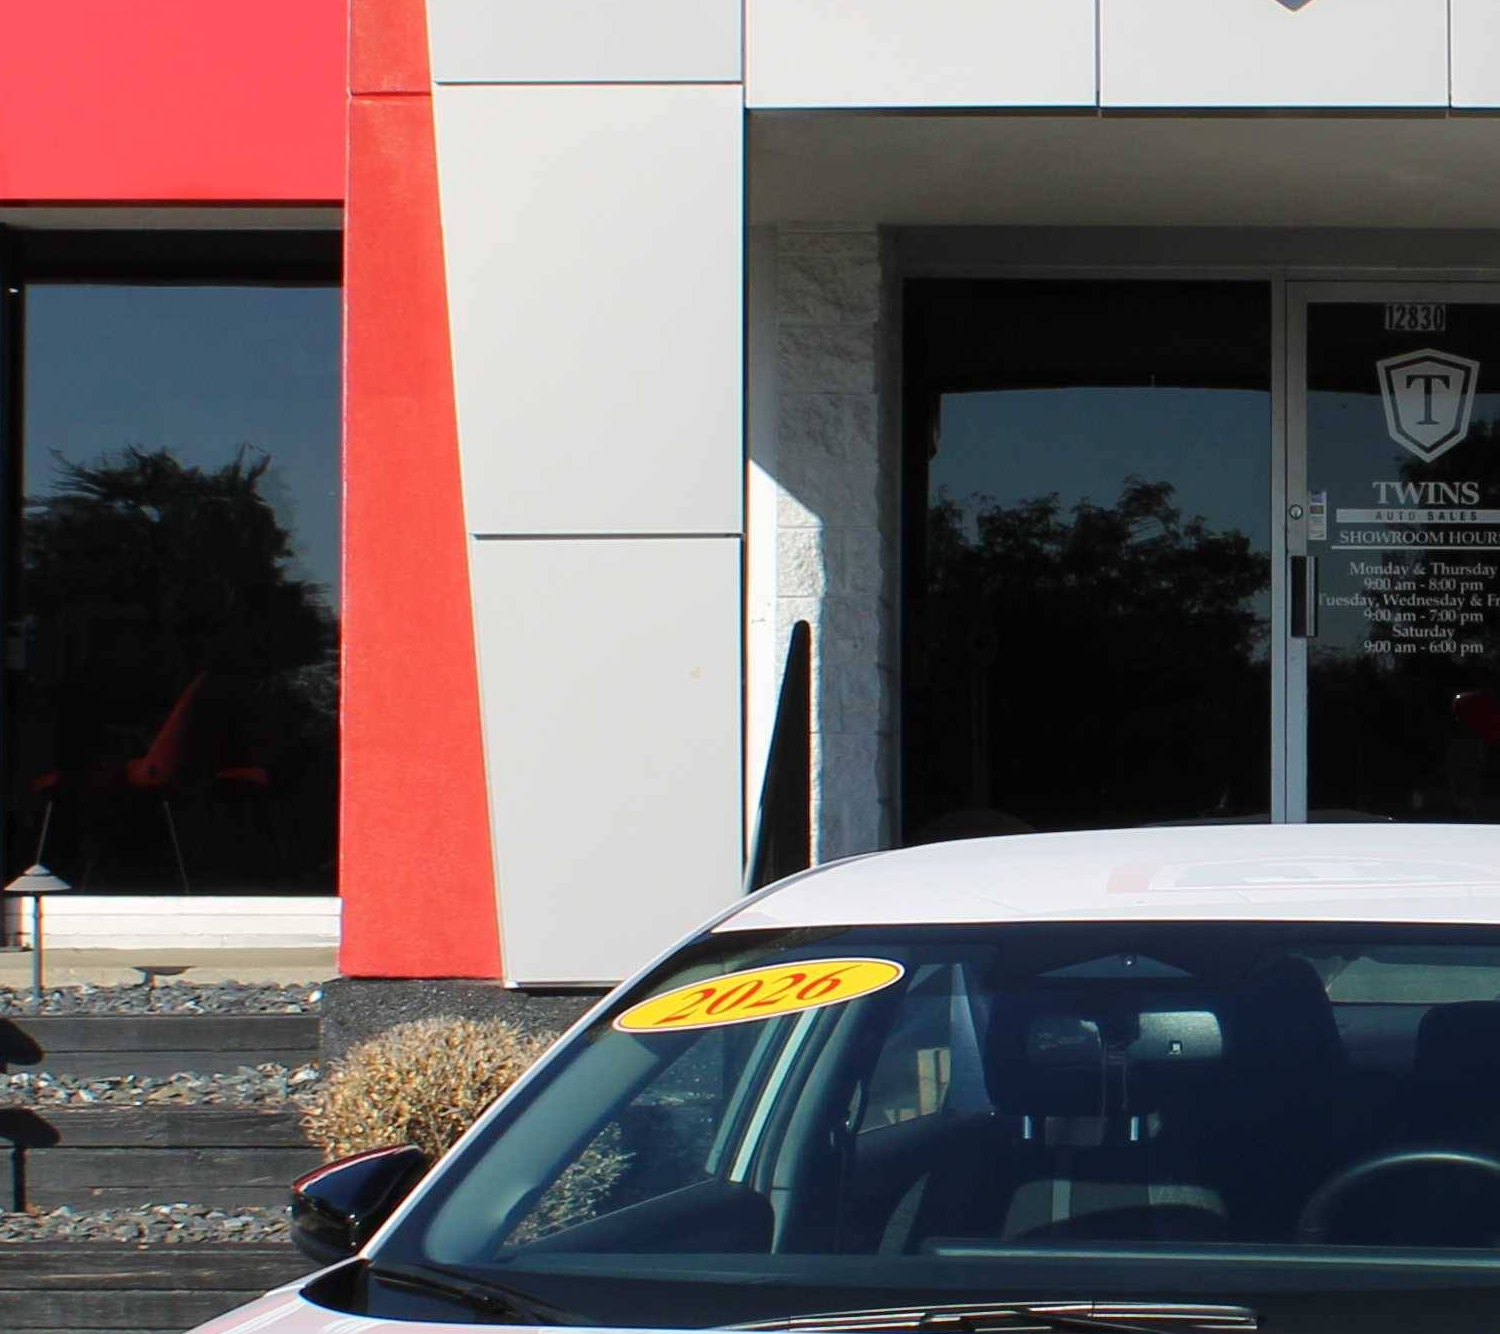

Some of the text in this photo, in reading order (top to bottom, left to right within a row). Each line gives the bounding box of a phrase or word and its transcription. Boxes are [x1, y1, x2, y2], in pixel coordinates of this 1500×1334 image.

[1387, 304, 1445, 330] 12830
[1405, 374, 1450, 425] T
[1372, 481, 1480, 505] TWINS
[1375, 510, 1478, 521] AUTO SALES
[1339, 530, 1444, 545] SHOWROOM
[1349, 562, 1498, 578] Monday & Thursday
[1363, 578, 1391, 591] 9:00
[1394, 580, 1417, 591] am
[1428, 578, 1457, 591] 8:00
[1460, 580, 1484, 594] pm
[1318, 593, 1380, 609] Tuesday,
[1383, 593, 1465, 609] Wednesday
[1470, 594, 1483, 607] &
[1363, 609, 1391, 622] 9:00
[1394, 611, 1417, 622] am
[1428, 609, 1457, 622] 7:00
[1460, 611, 1484, 625] pm
[1392, 624, 1456, 640] Saturday
[1363, 640, 1391, 653] 9:00
[1394, 642, 1417, 653] am
[1428, 640, 1457, 653] 6:00
[1460, 642, 1484, 656] pm
[653, 964, 862, 1025] 2026
